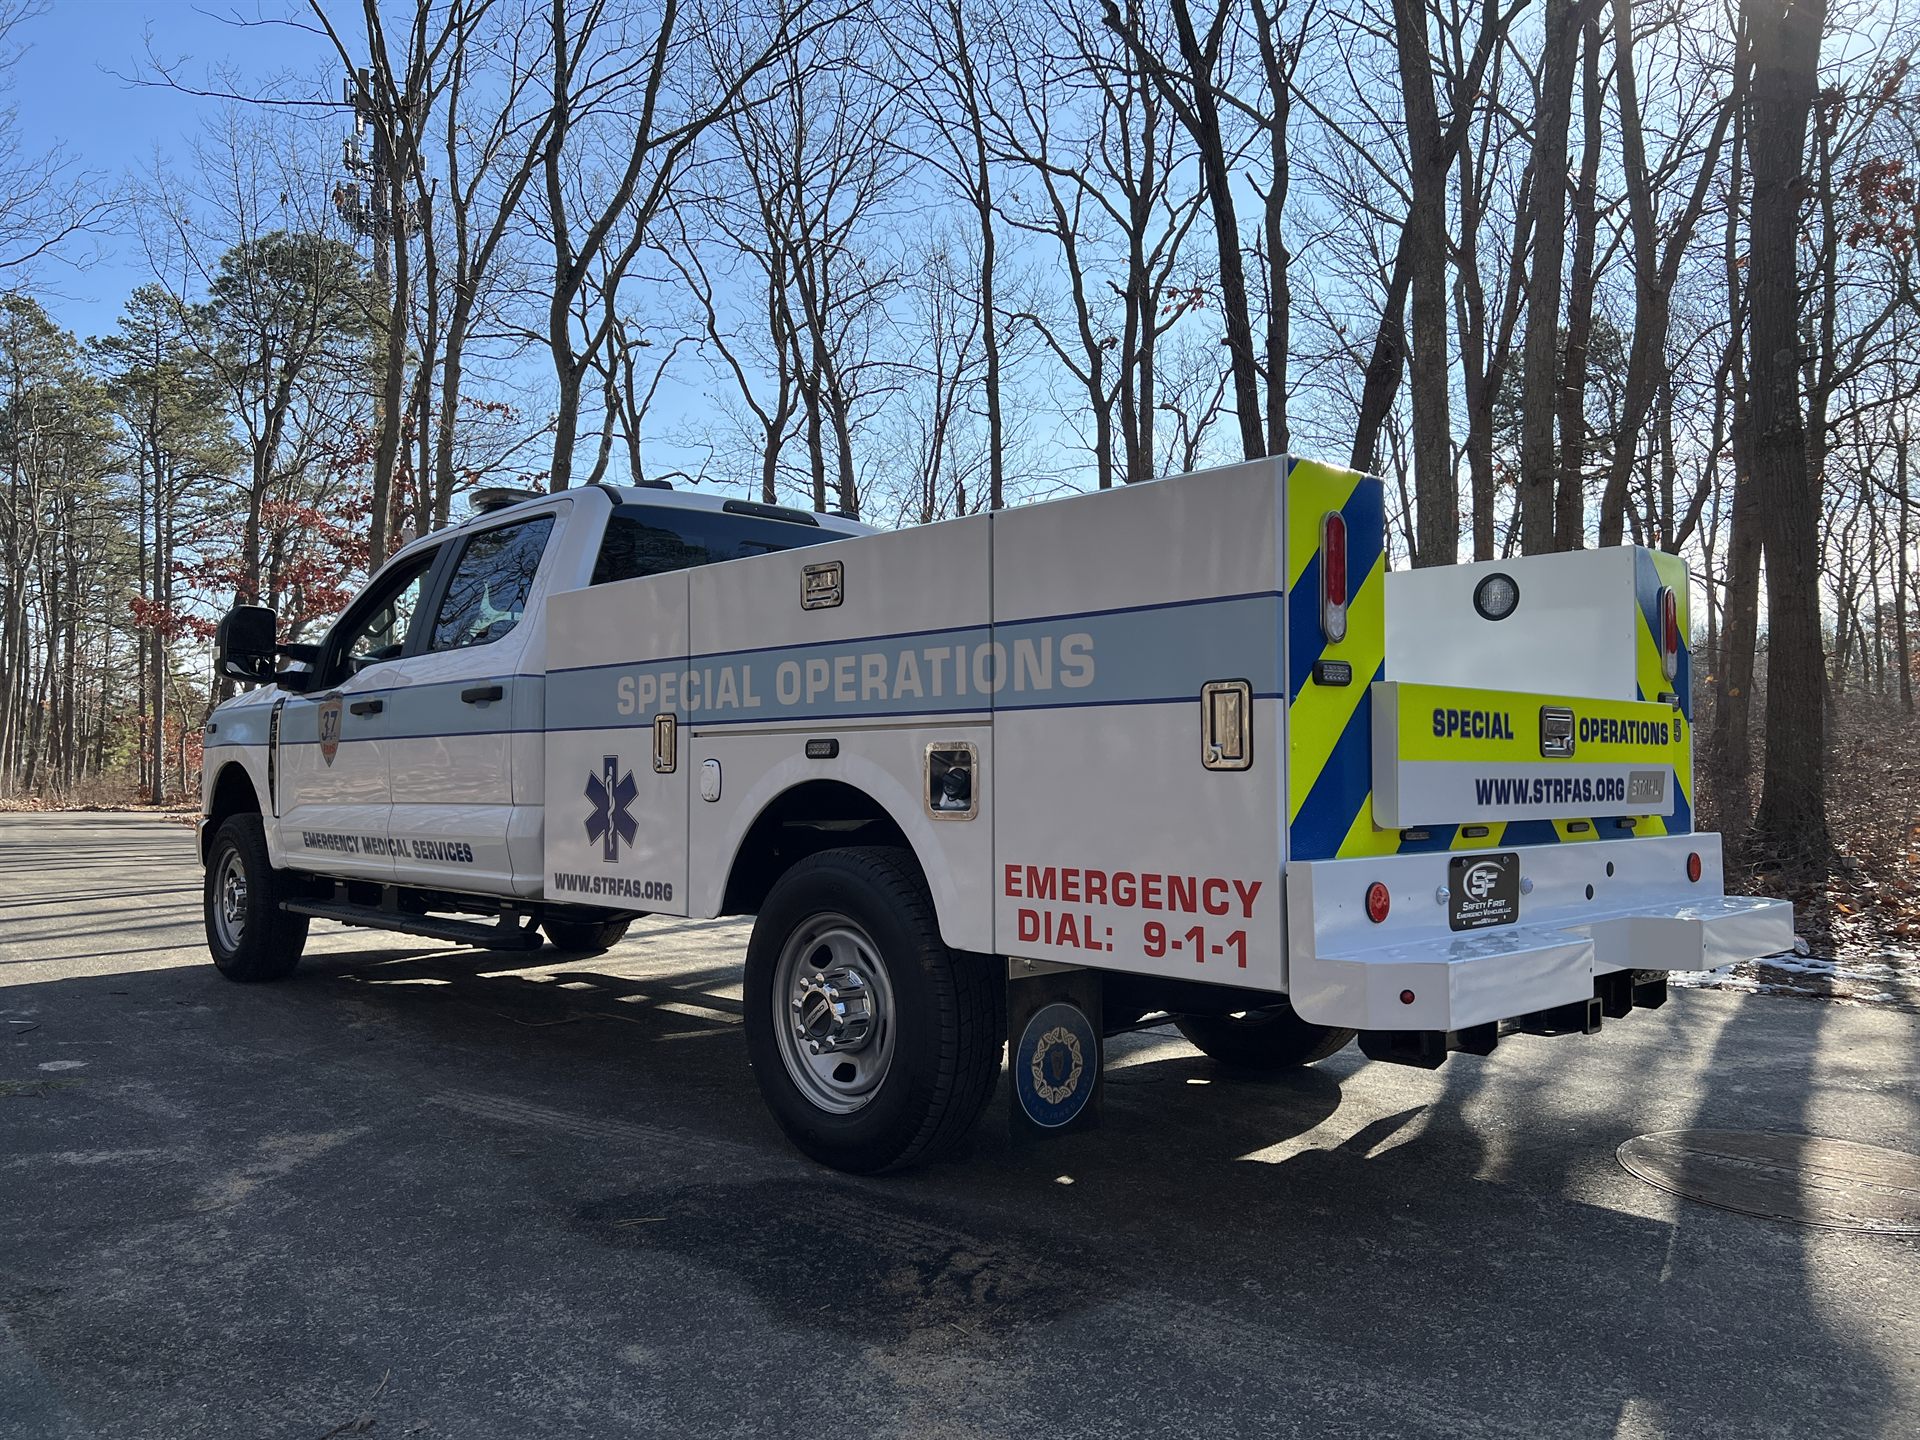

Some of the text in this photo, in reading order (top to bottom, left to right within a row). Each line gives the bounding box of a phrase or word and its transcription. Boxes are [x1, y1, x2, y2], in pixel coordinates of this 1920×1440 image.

[617, 632, 1096, 715] SPECIAL OPERATIONS
[321, 710, 339, 741] 37
[1432, 708, 1669, 745] SPECIAL OPERATIONS
[1475, 777, 1625, 806] WWW.STRFAS.ORG
[1632, 779, 1660, 796] STAHL
[302, 831, 473, 863] EMERGENCY MEDICAL SERVICES
[554, 872, 673, 902] WWW.STRFAS.ORG
[1004, 863, 1262, 919] EMERGENCY
[1018, 908, 1247, 969] DIAL: 9-1-1
